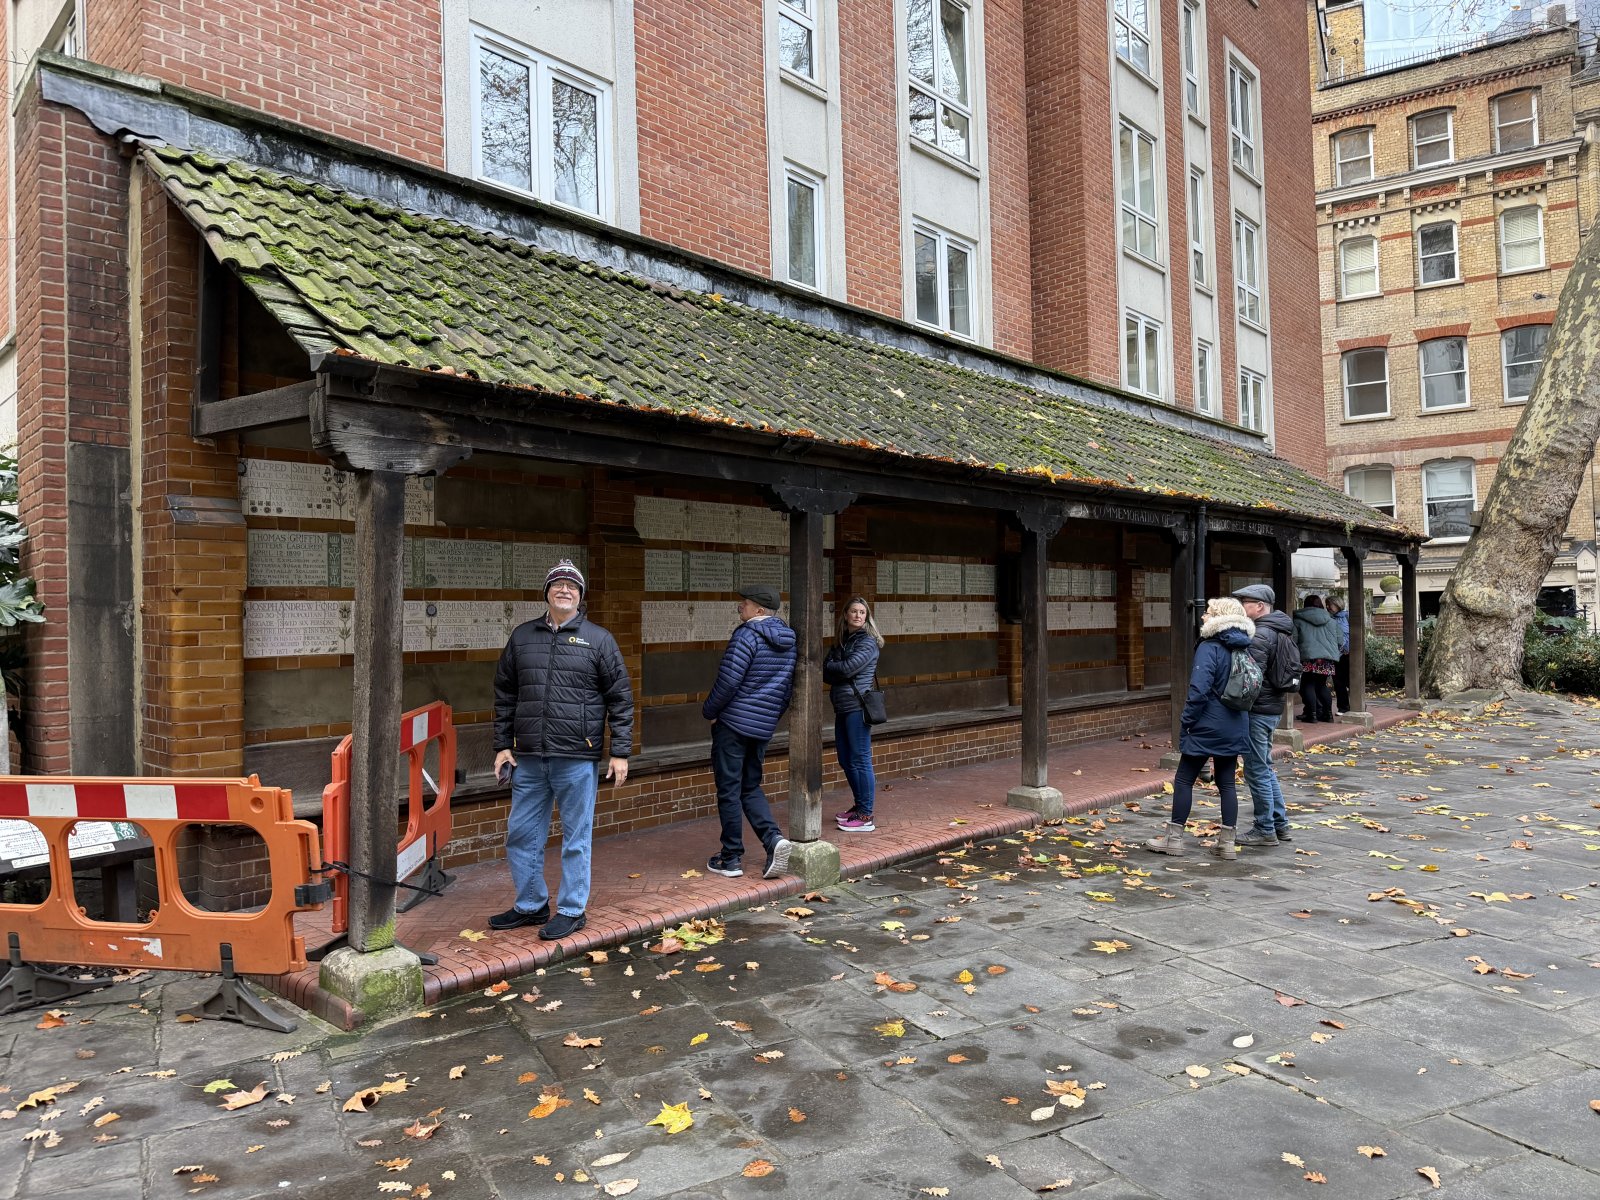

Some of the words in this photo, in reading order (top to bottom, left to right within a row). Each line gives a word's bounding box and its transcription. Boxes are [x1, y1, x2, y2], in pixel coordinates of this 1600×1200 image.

[251, 460, 287, 472] ALFRED
[292, 464, 321, 475] SMITH
[249, 471, 273, 479] POLICE
[275, 473, 312, 481] CONSTABLE
[1093, 504, 1159, 523] COMMEMORATION
[1161, 514, 1171, 525] OF
[1232, 519, 1245, 531] SELF
[1248, 522, 1274, 535] SACRIFICE
[251, 533, 286, 542] THOMAS
[290, 534, 324, 543] GRIFFIN
[439, 541, 464, 550] MARY
[465, 542, 493, 551] ROGERS
[248, 602, 277, 611] JOSEPH
[279, 602, 313, 611] ANDREW
[316, 602, 339, 611] FORD
[439, 602, 469, 611] EDMUND
